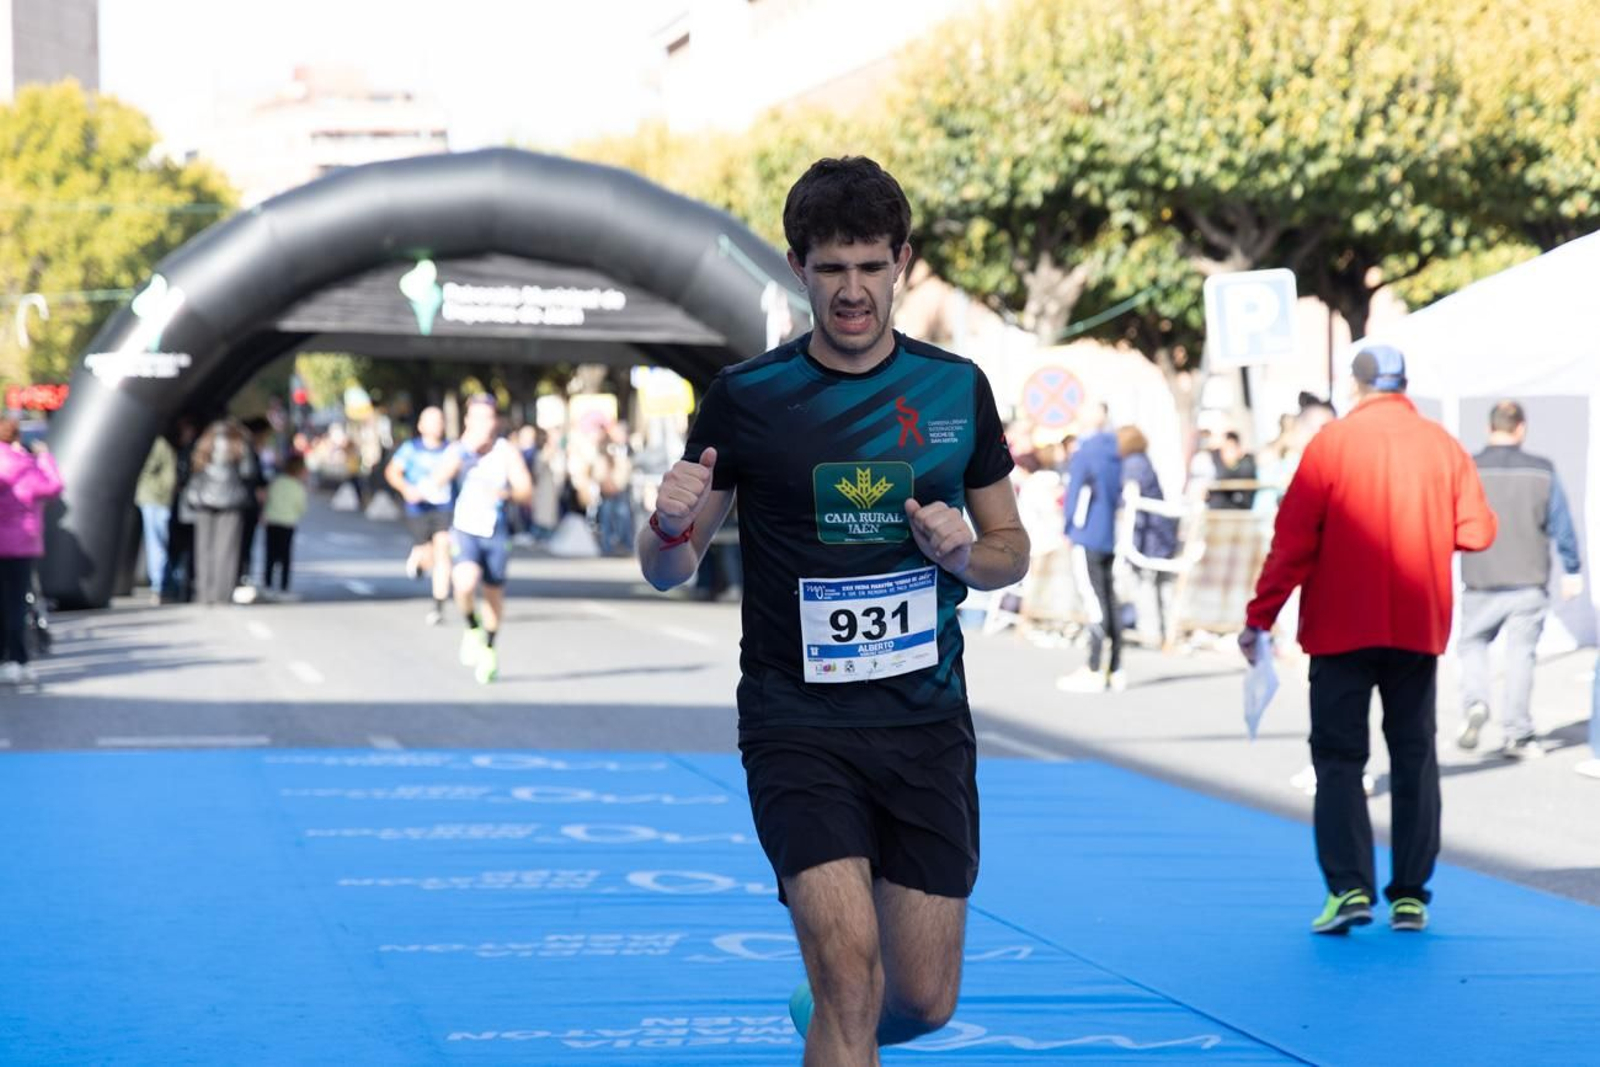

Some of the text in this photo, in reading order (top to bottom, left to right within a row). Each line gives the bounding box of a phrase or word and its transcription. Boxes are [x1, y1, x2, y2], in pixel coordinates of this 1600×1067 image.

[1225, 283, 1280, 355] P
[824, 512, 903, 524] CAJA RURAL
[829, 600, 909, 643] 931
[857, 640, 894, 653] ALBERTO
[446, 1026, 797, 1042] MARATON
[560, 1036, 795, 1049] MEDIA
